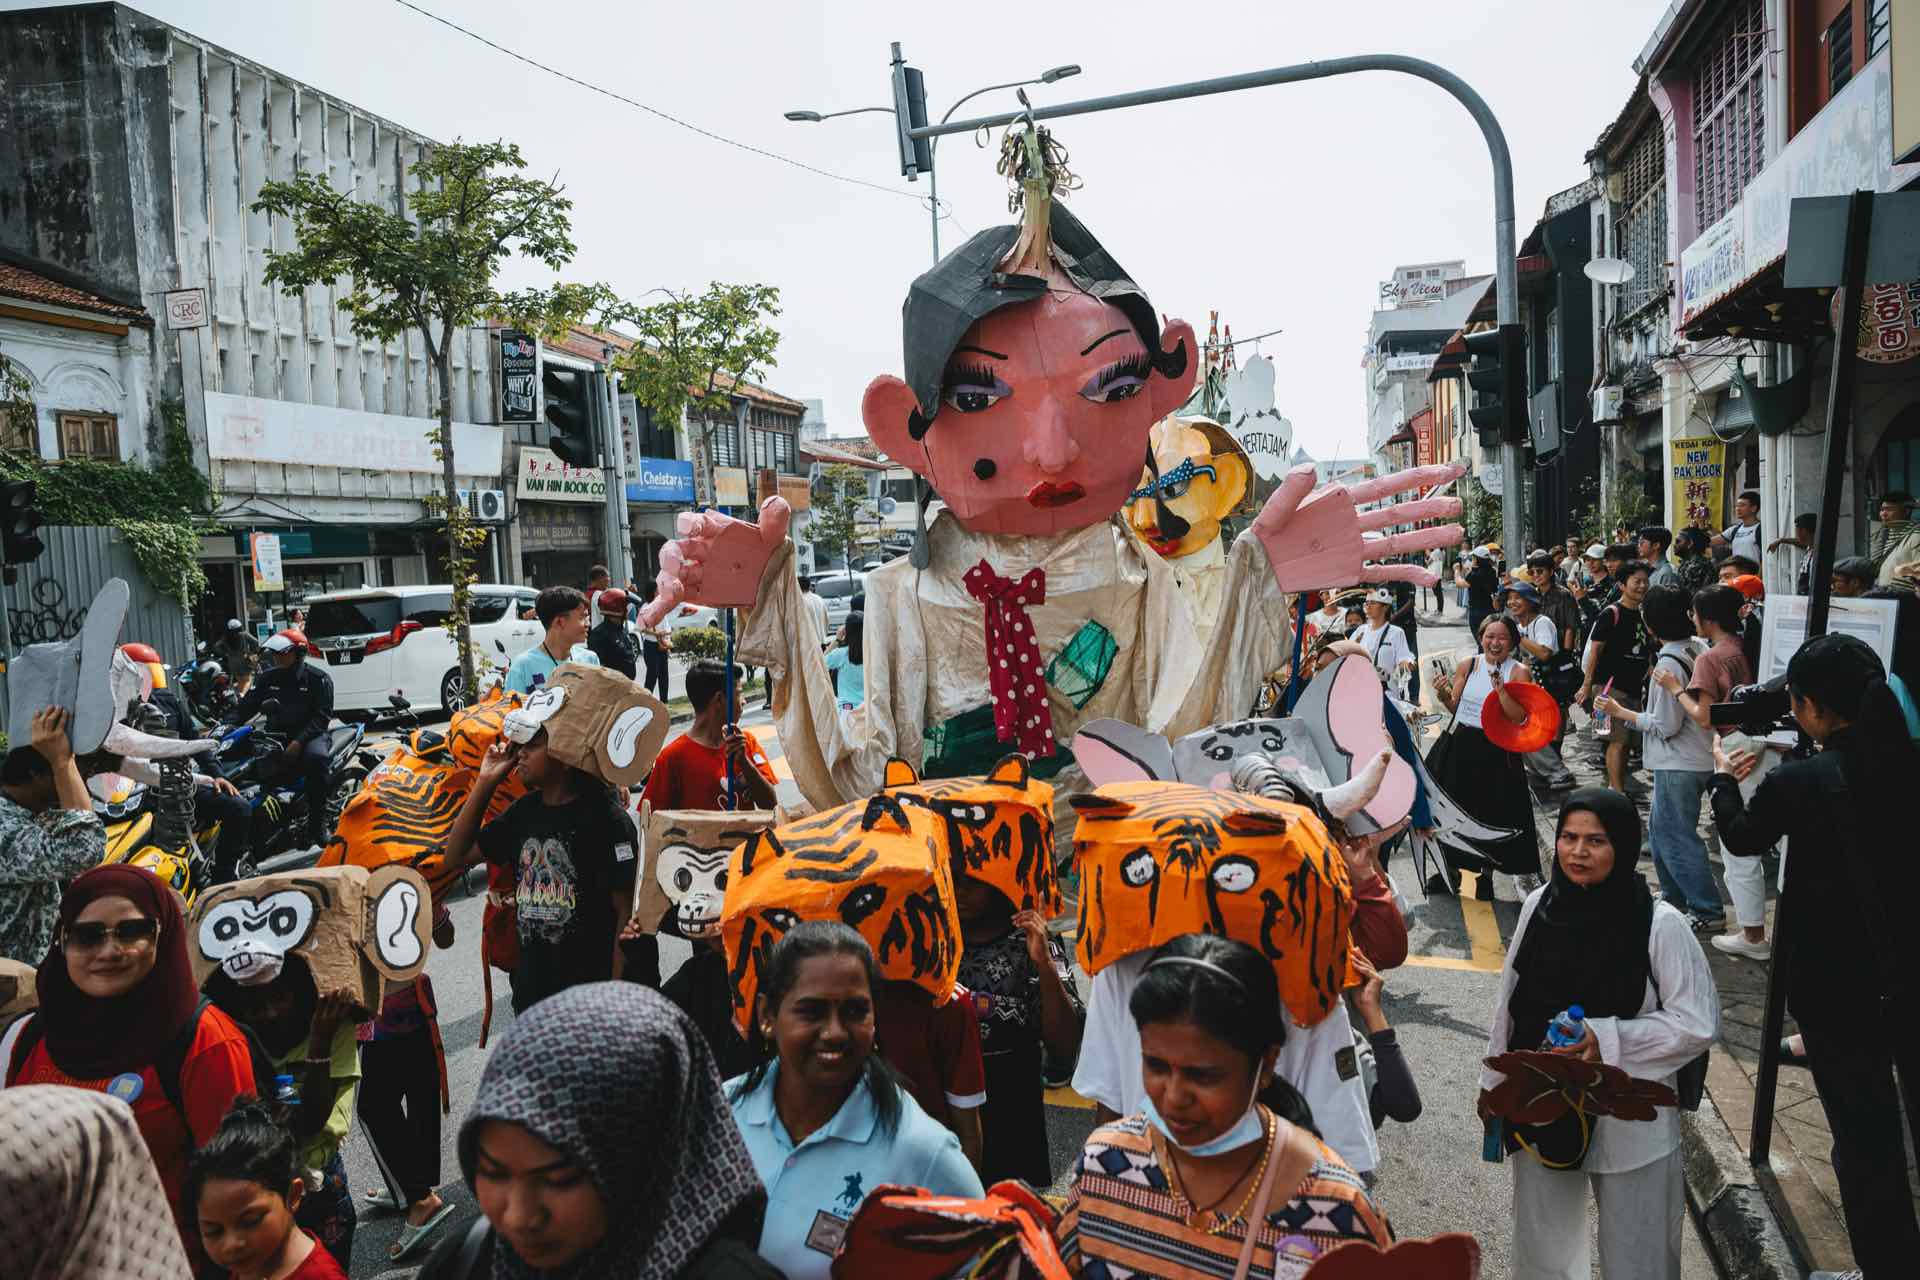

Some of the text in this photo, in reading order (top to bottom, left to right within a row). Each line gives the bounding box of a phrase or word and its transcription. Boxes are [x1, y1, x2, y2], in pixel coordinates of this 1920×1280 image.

[1381, 281, 1442, 298] Sky View
[172, 301, 201, 318] CRC
[1687, 449, 1708, 463] NEW
[1674, 464, 1721, 478] PAK HOCK
[526, 478, 544, 491] VAN
[547, 479, 562, 492] HIN
[564, 481, 589, 493] BOOK
